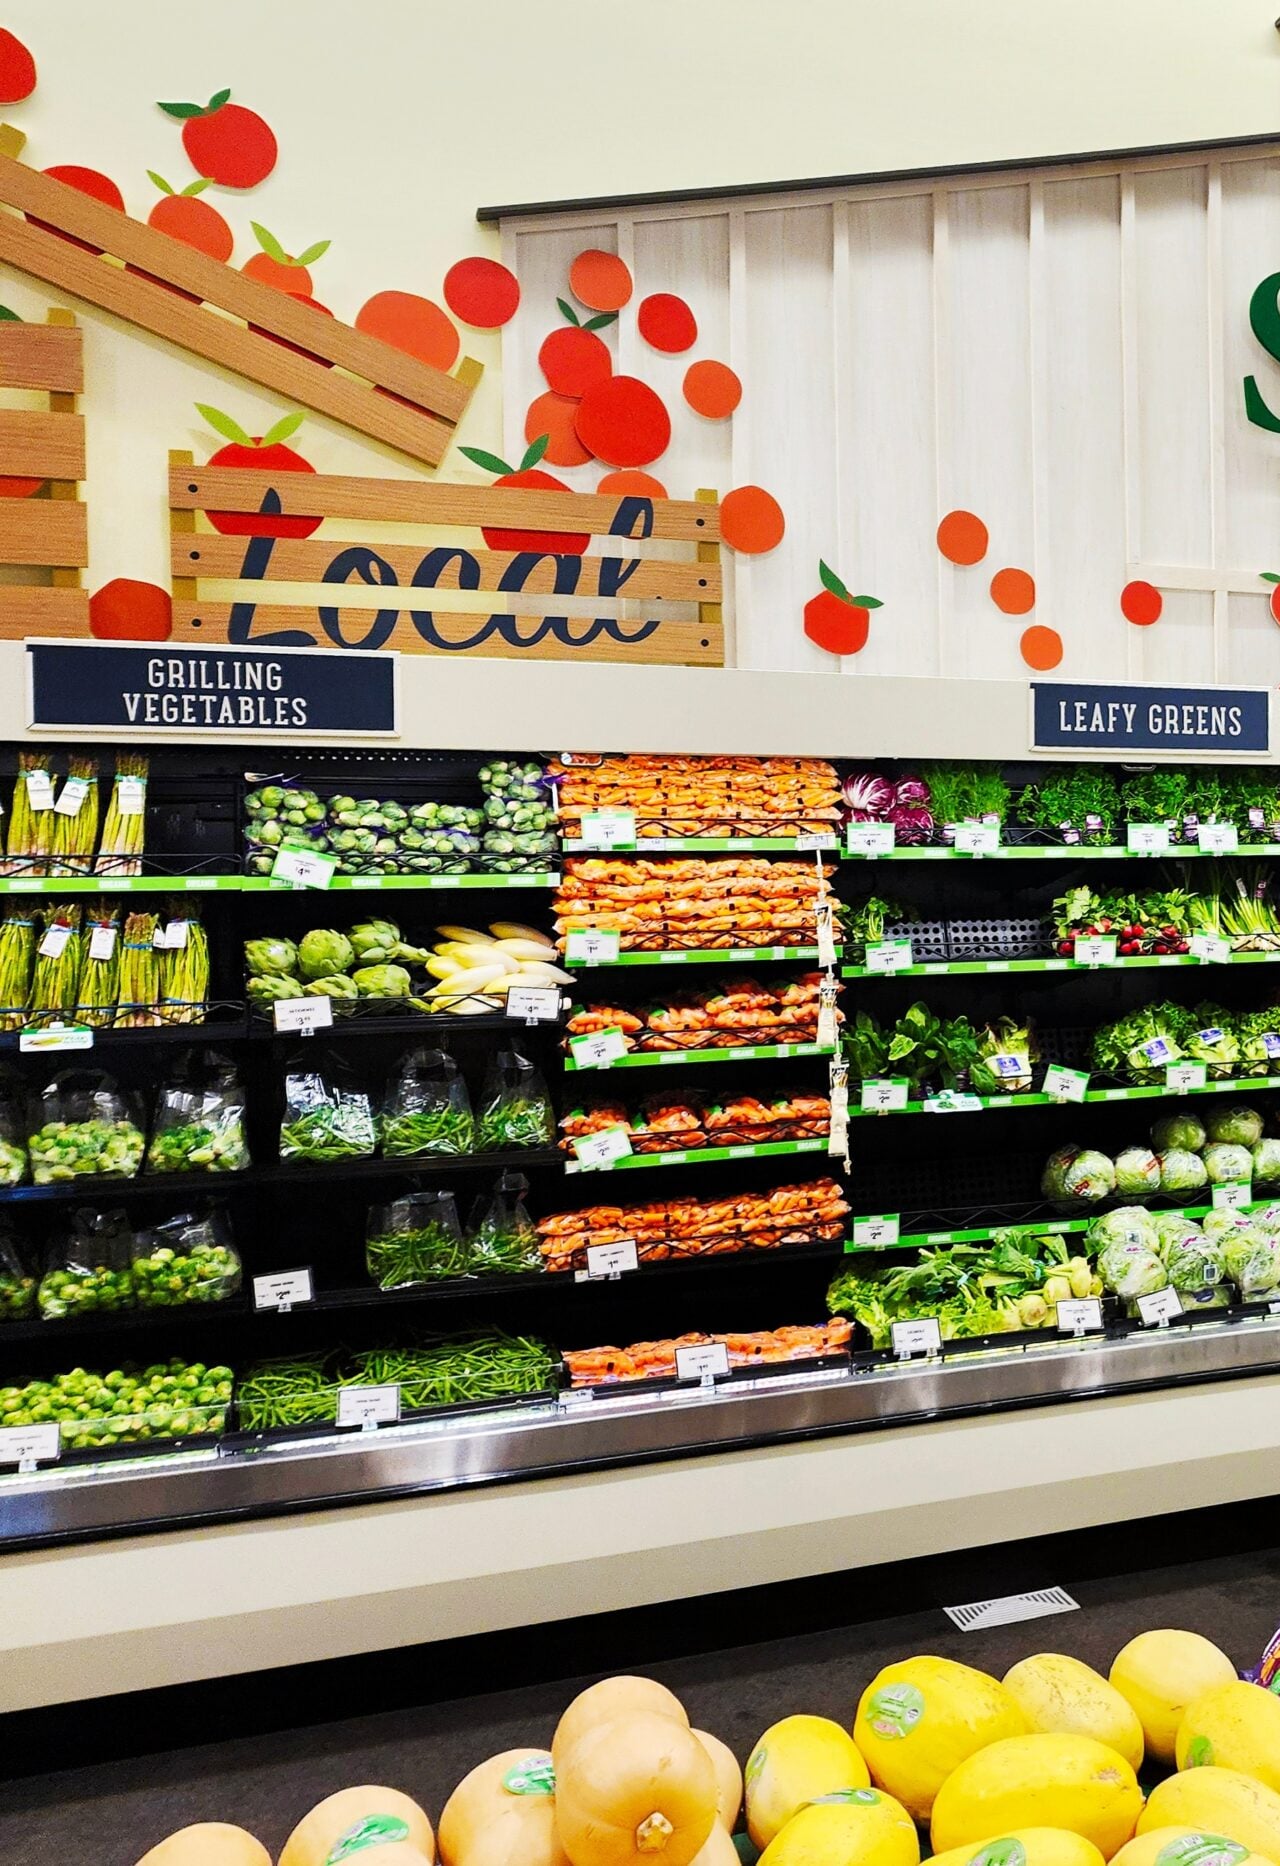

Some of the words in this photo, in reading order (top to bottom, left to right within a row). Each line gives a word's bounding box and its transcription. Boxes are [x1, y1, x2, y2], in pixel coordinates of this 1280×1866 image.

[228, 487, 664, 651] Local
[147, 659, 283, 691] GRILLING
[122, 693, 308, 727] VEGETABLES
[1059, 700, 1136, 734] LEAFY
[1149, 704, 1242, 737] GREENS
